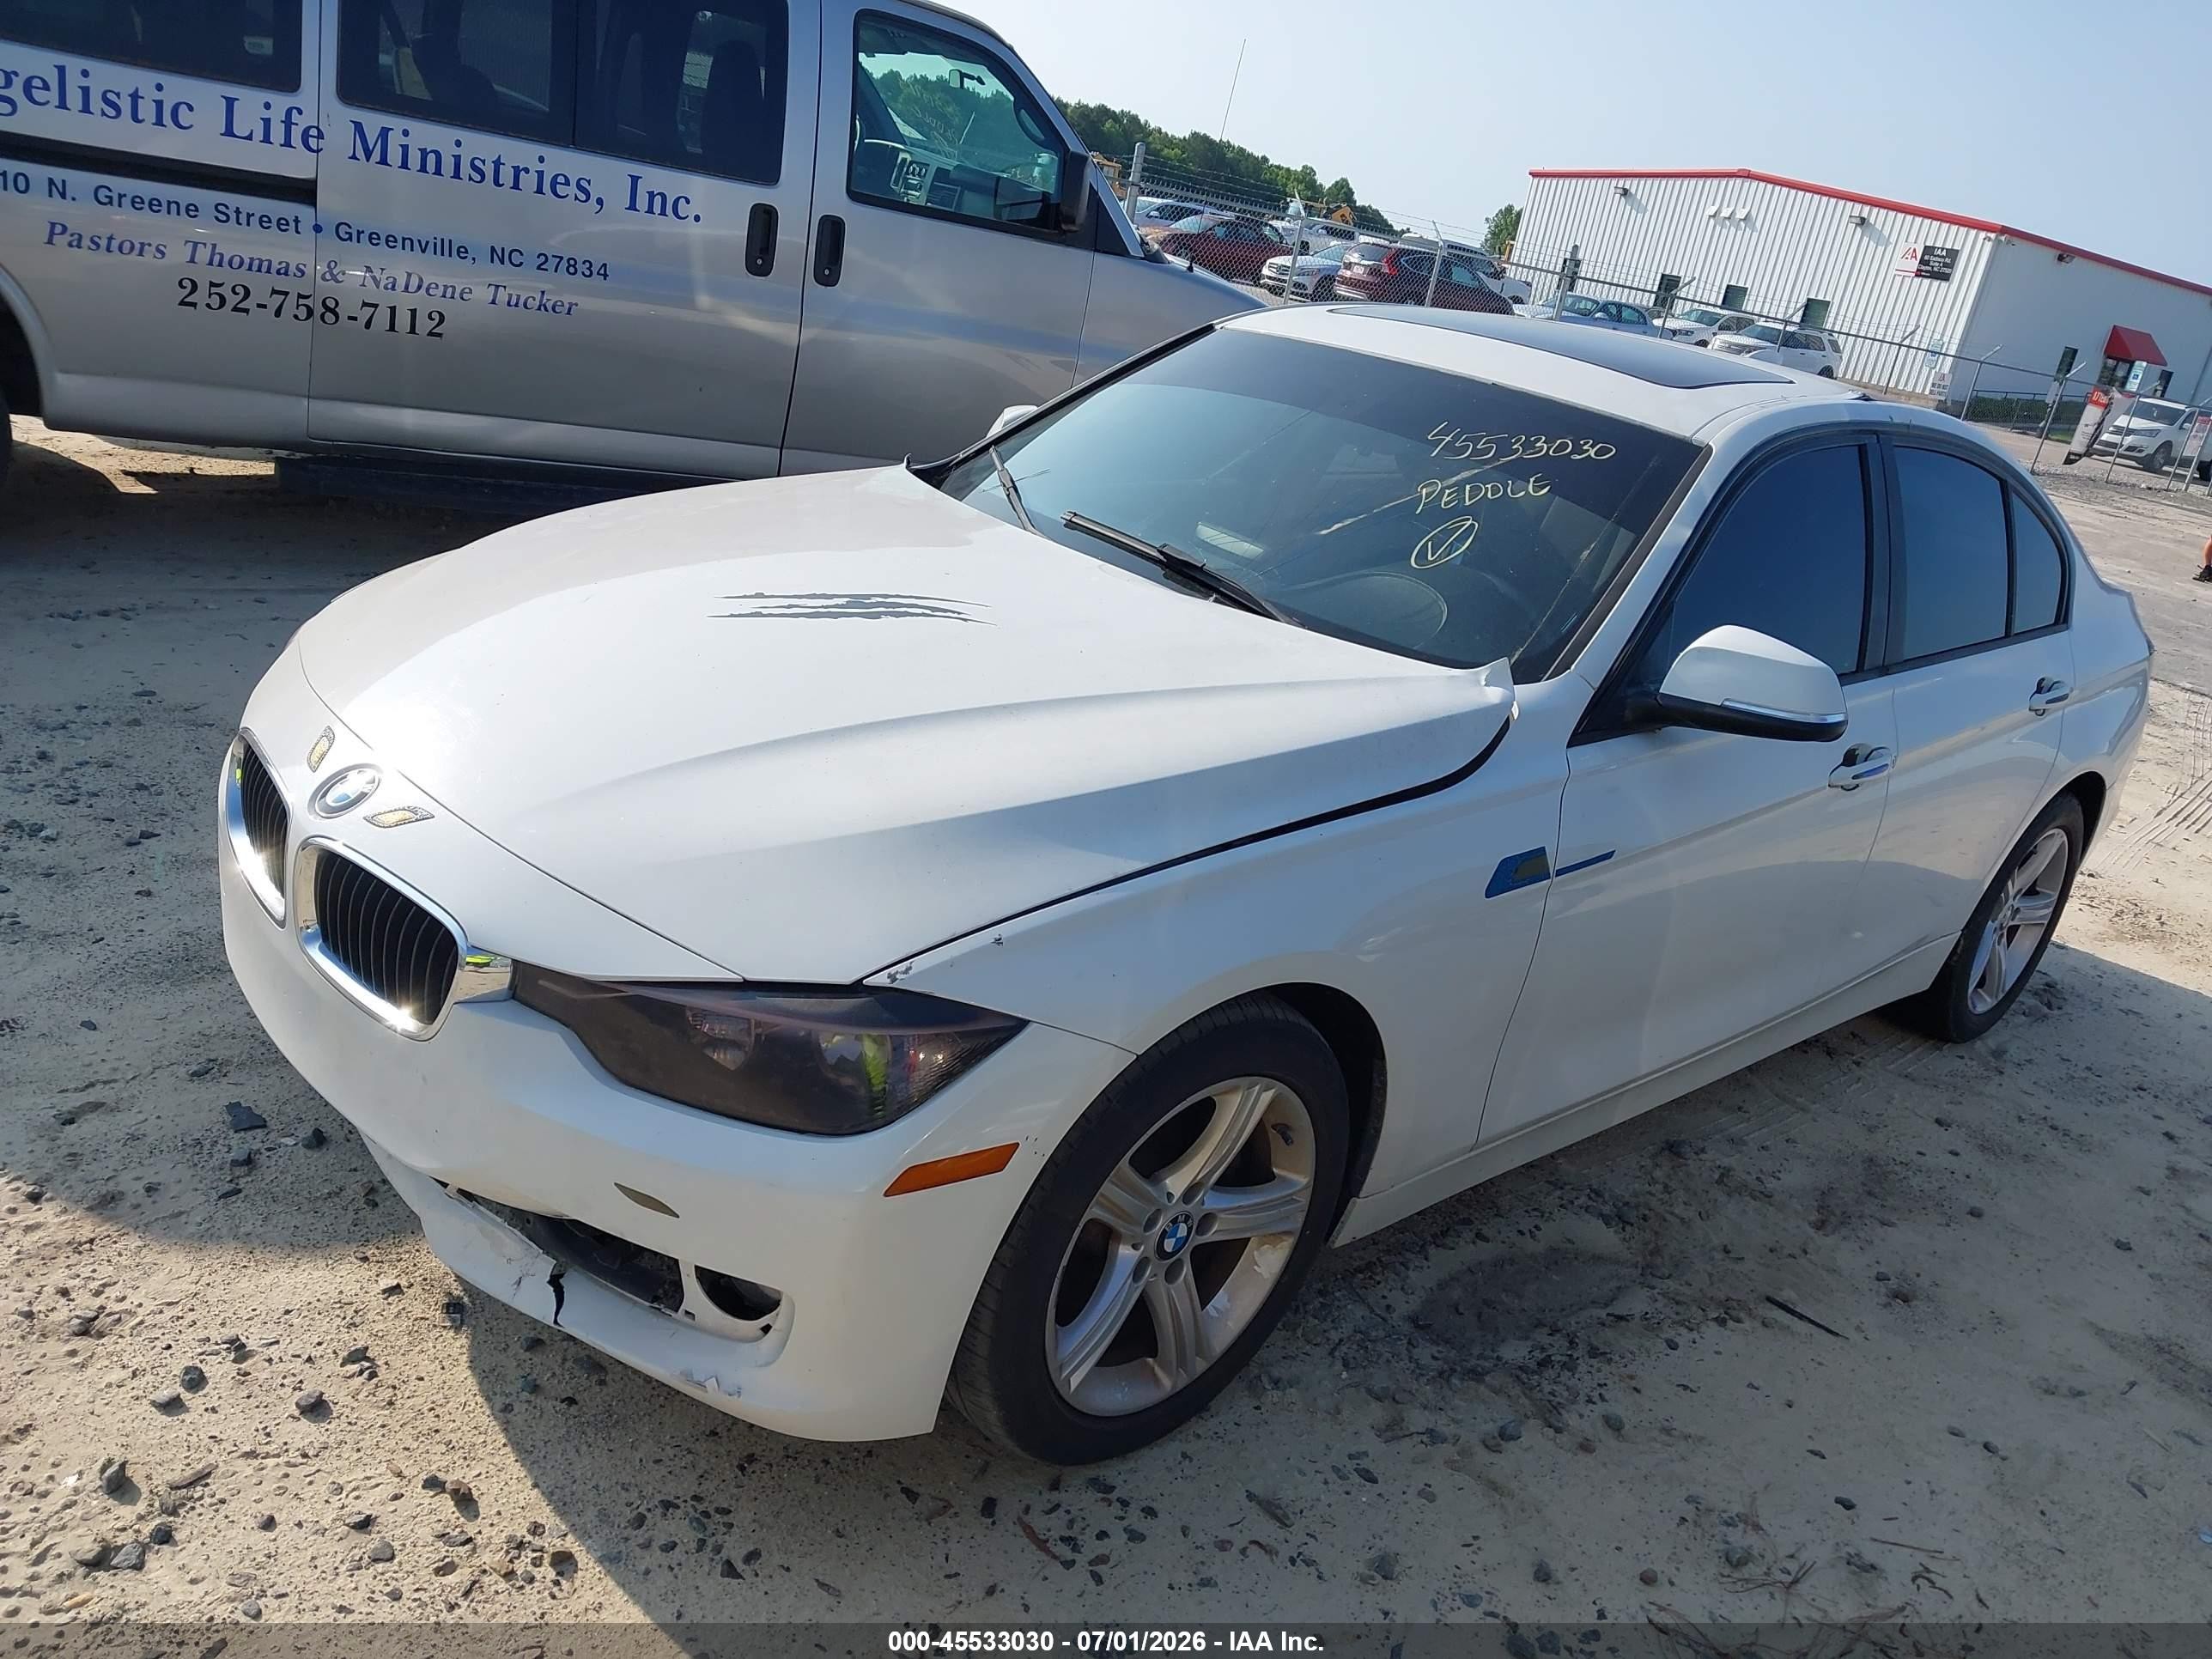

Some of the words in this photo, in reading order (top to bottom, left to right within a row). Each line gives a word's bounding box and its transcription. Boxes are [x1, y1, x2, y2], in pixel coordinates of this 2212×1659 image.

[220, 94, 325, 154] Life
[348, 119, 605, 215] Ministries,
[623, 173, 702, 224] Inc.
[47, 179, 77, 203] N.
[94, 184, 200, 219] Greene
[214, 201, 301, 235] Street
[335, 222, 477, 265] Greenville,
[489, 246, 525, 268] NC
[536, 253, 610, 282] 27834
[1934, 248, 1947, 257] IAA
[45, 221, 167, 260] Pastors
[185, 240, 307, 279] Thomas
[320, 259, 346, 284] &
[361, 265, 474, 302] NaDene
[486, 283, 579, 318] Tucker
[178, 276, 447, 340] 252-758-7112
[1427, 421, 1616, 459] 45533030
[1416, 474, 1552, 514] PEDDLE
